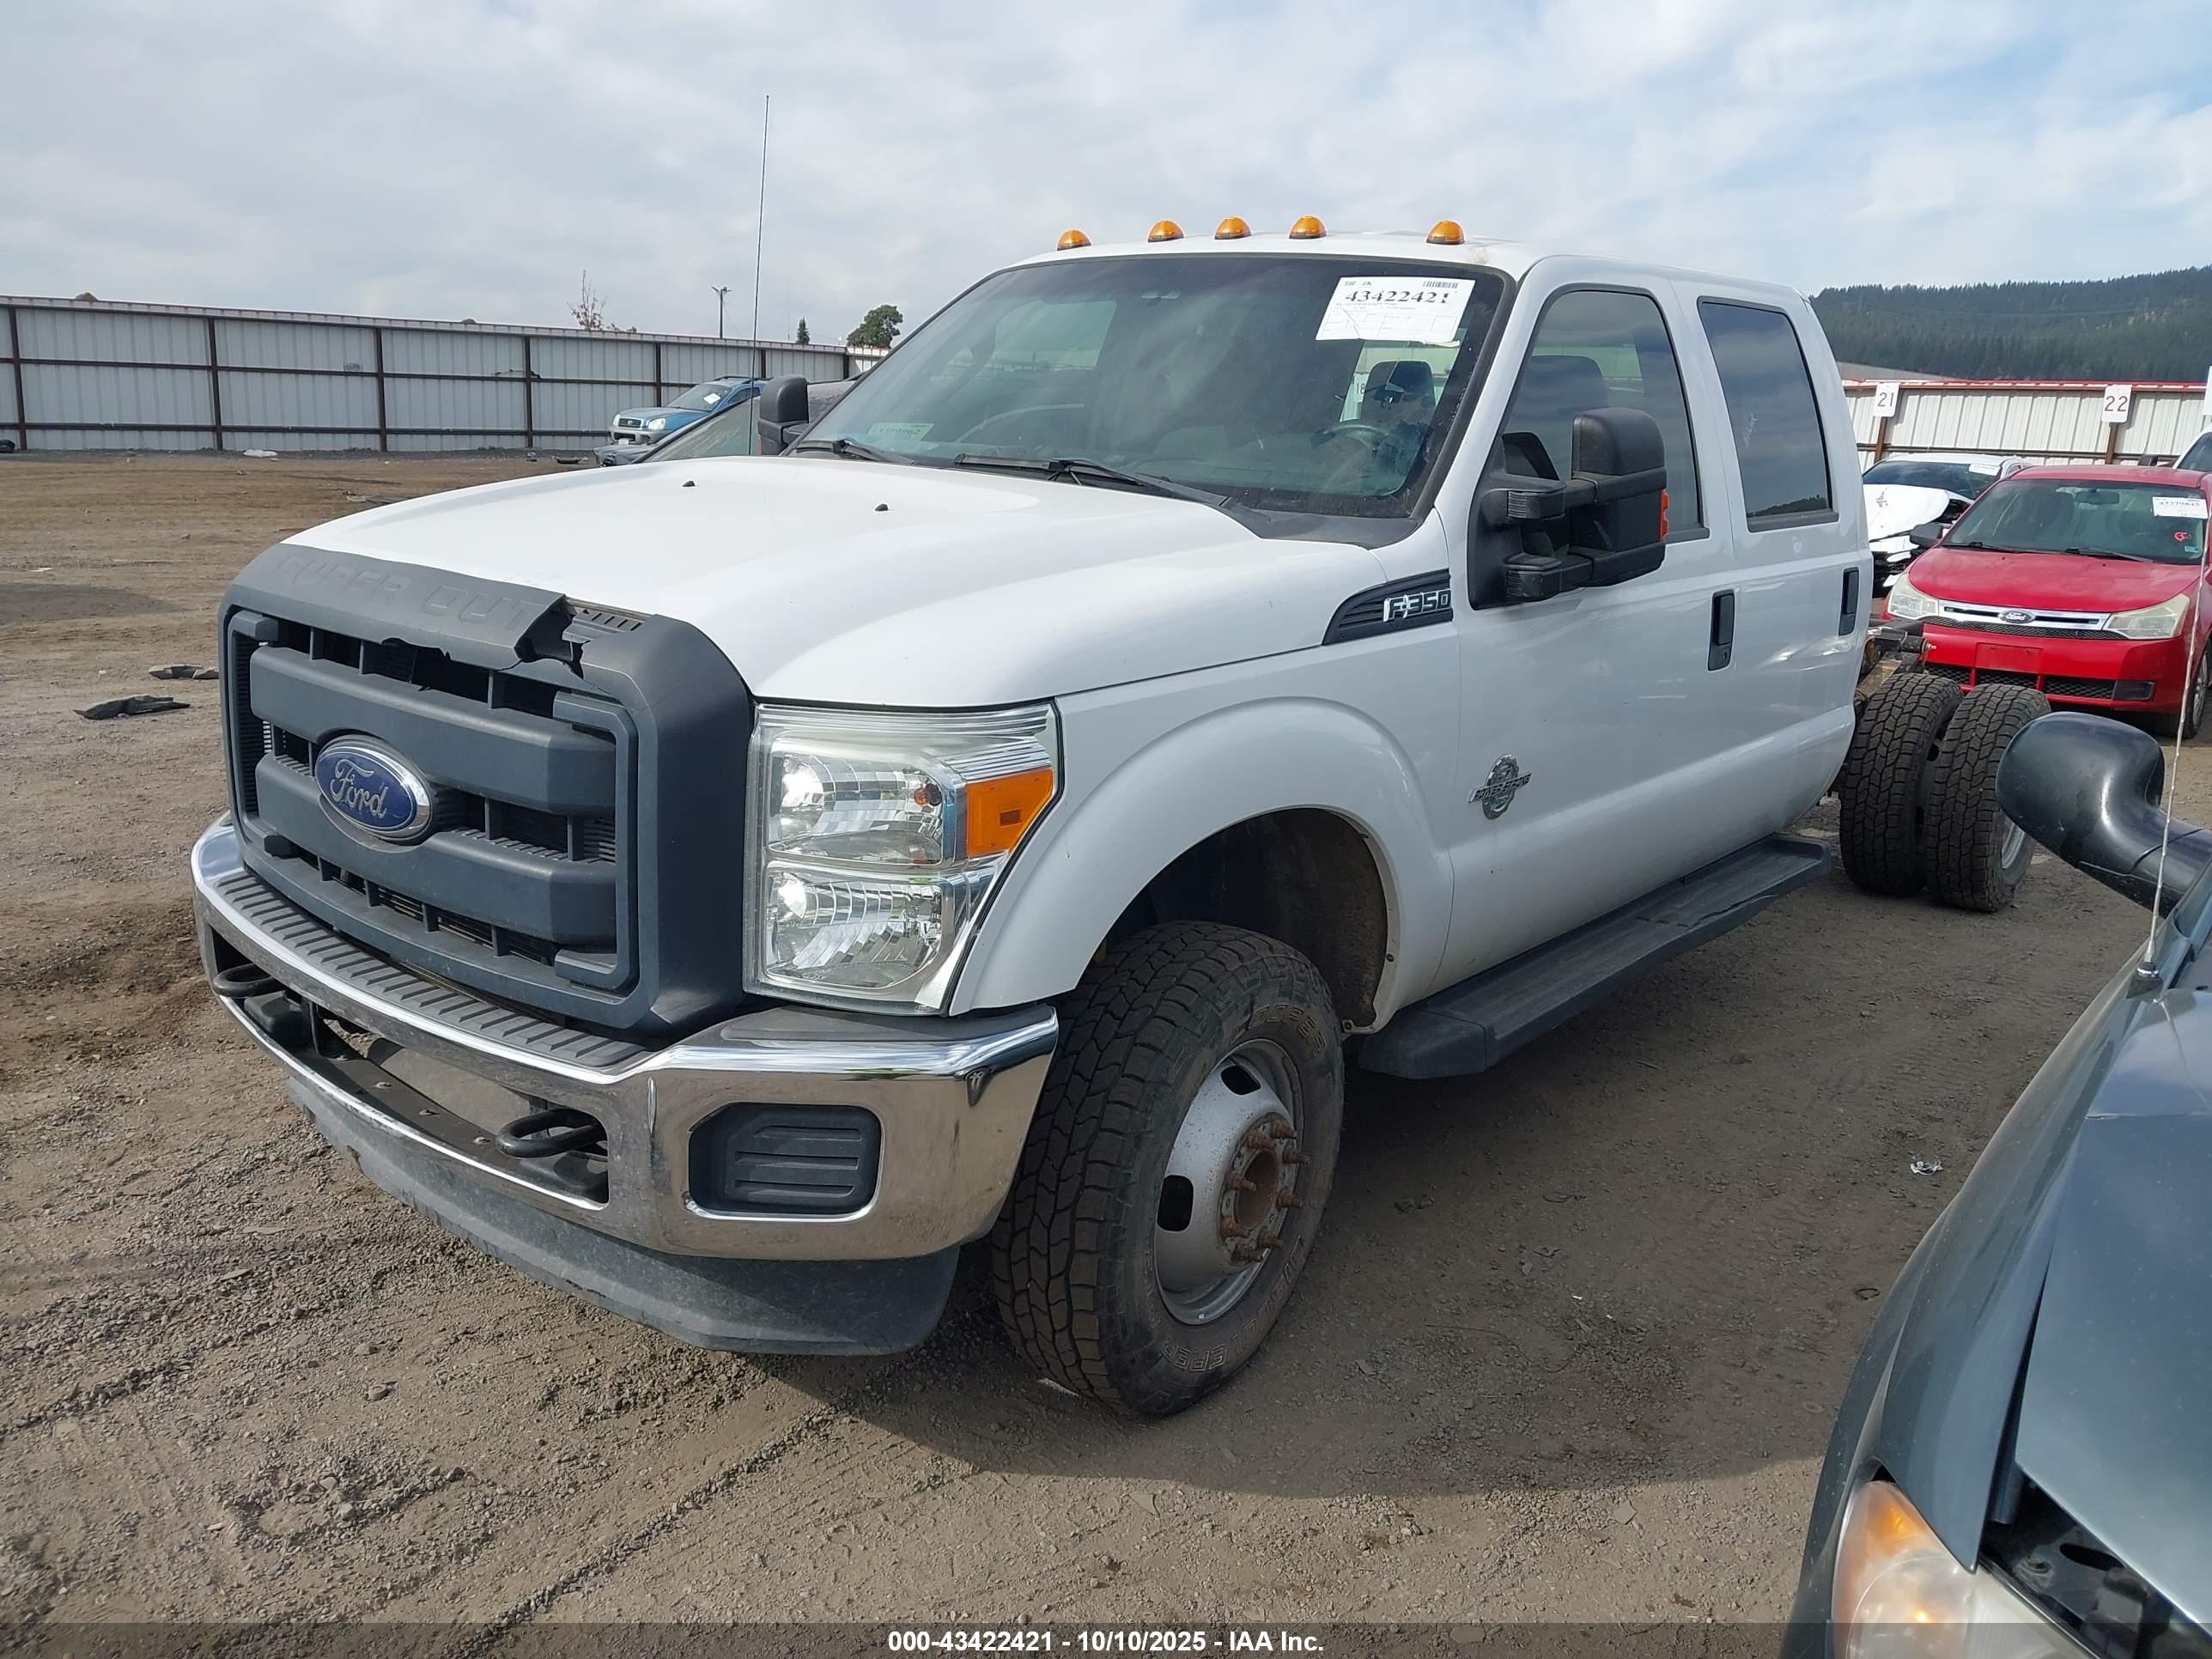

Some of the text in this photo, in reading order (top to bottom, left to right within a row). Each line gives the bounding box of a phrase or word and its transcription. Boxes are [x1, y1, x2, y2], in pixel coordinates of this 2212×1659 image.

[1345, 289, 1449, 304] 43422421
[1877, 392, 1895, 408] 21
[2105, 396, 2128, 412] 22
[2006, 611, 2027, 621] Ford
[330, 759, 389, 818] Ford
